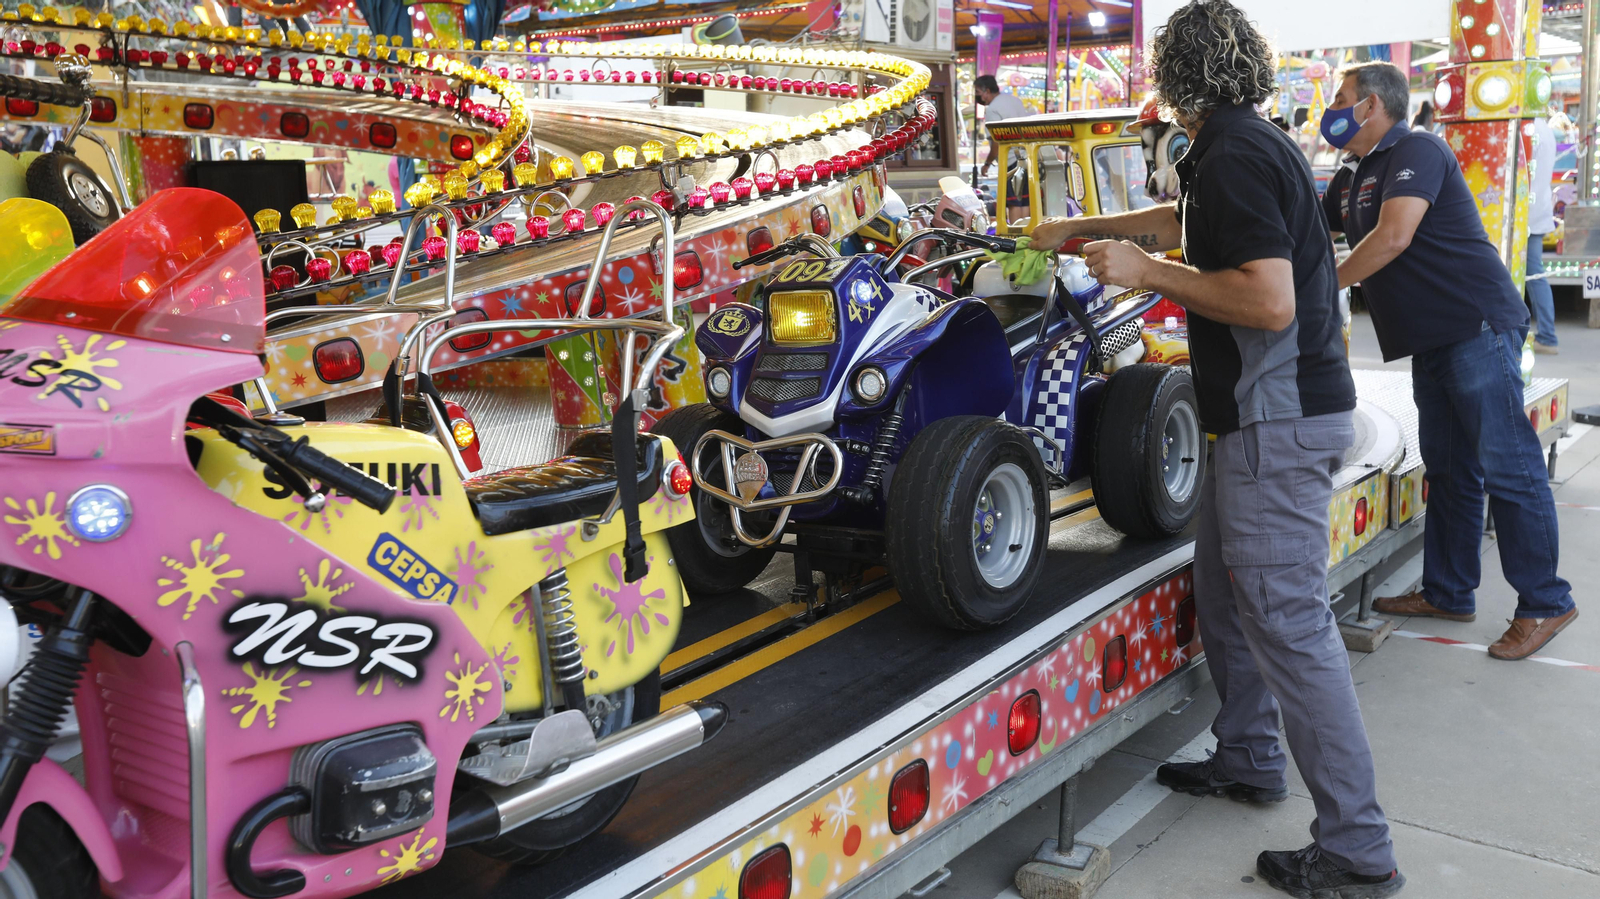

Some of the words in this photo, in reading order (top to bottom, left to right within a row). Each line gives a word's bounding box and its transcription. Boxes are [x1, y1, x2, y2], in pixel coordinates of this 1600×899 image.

[993, 127, 1021, 140] SPECIAL
[1021, 124, 1074, 139] CONSTRUCTION
[778, 261, 850, 282] 092
[374, 541, 457, 604] CEPSA
[229, 602, 433, 678] NSR
